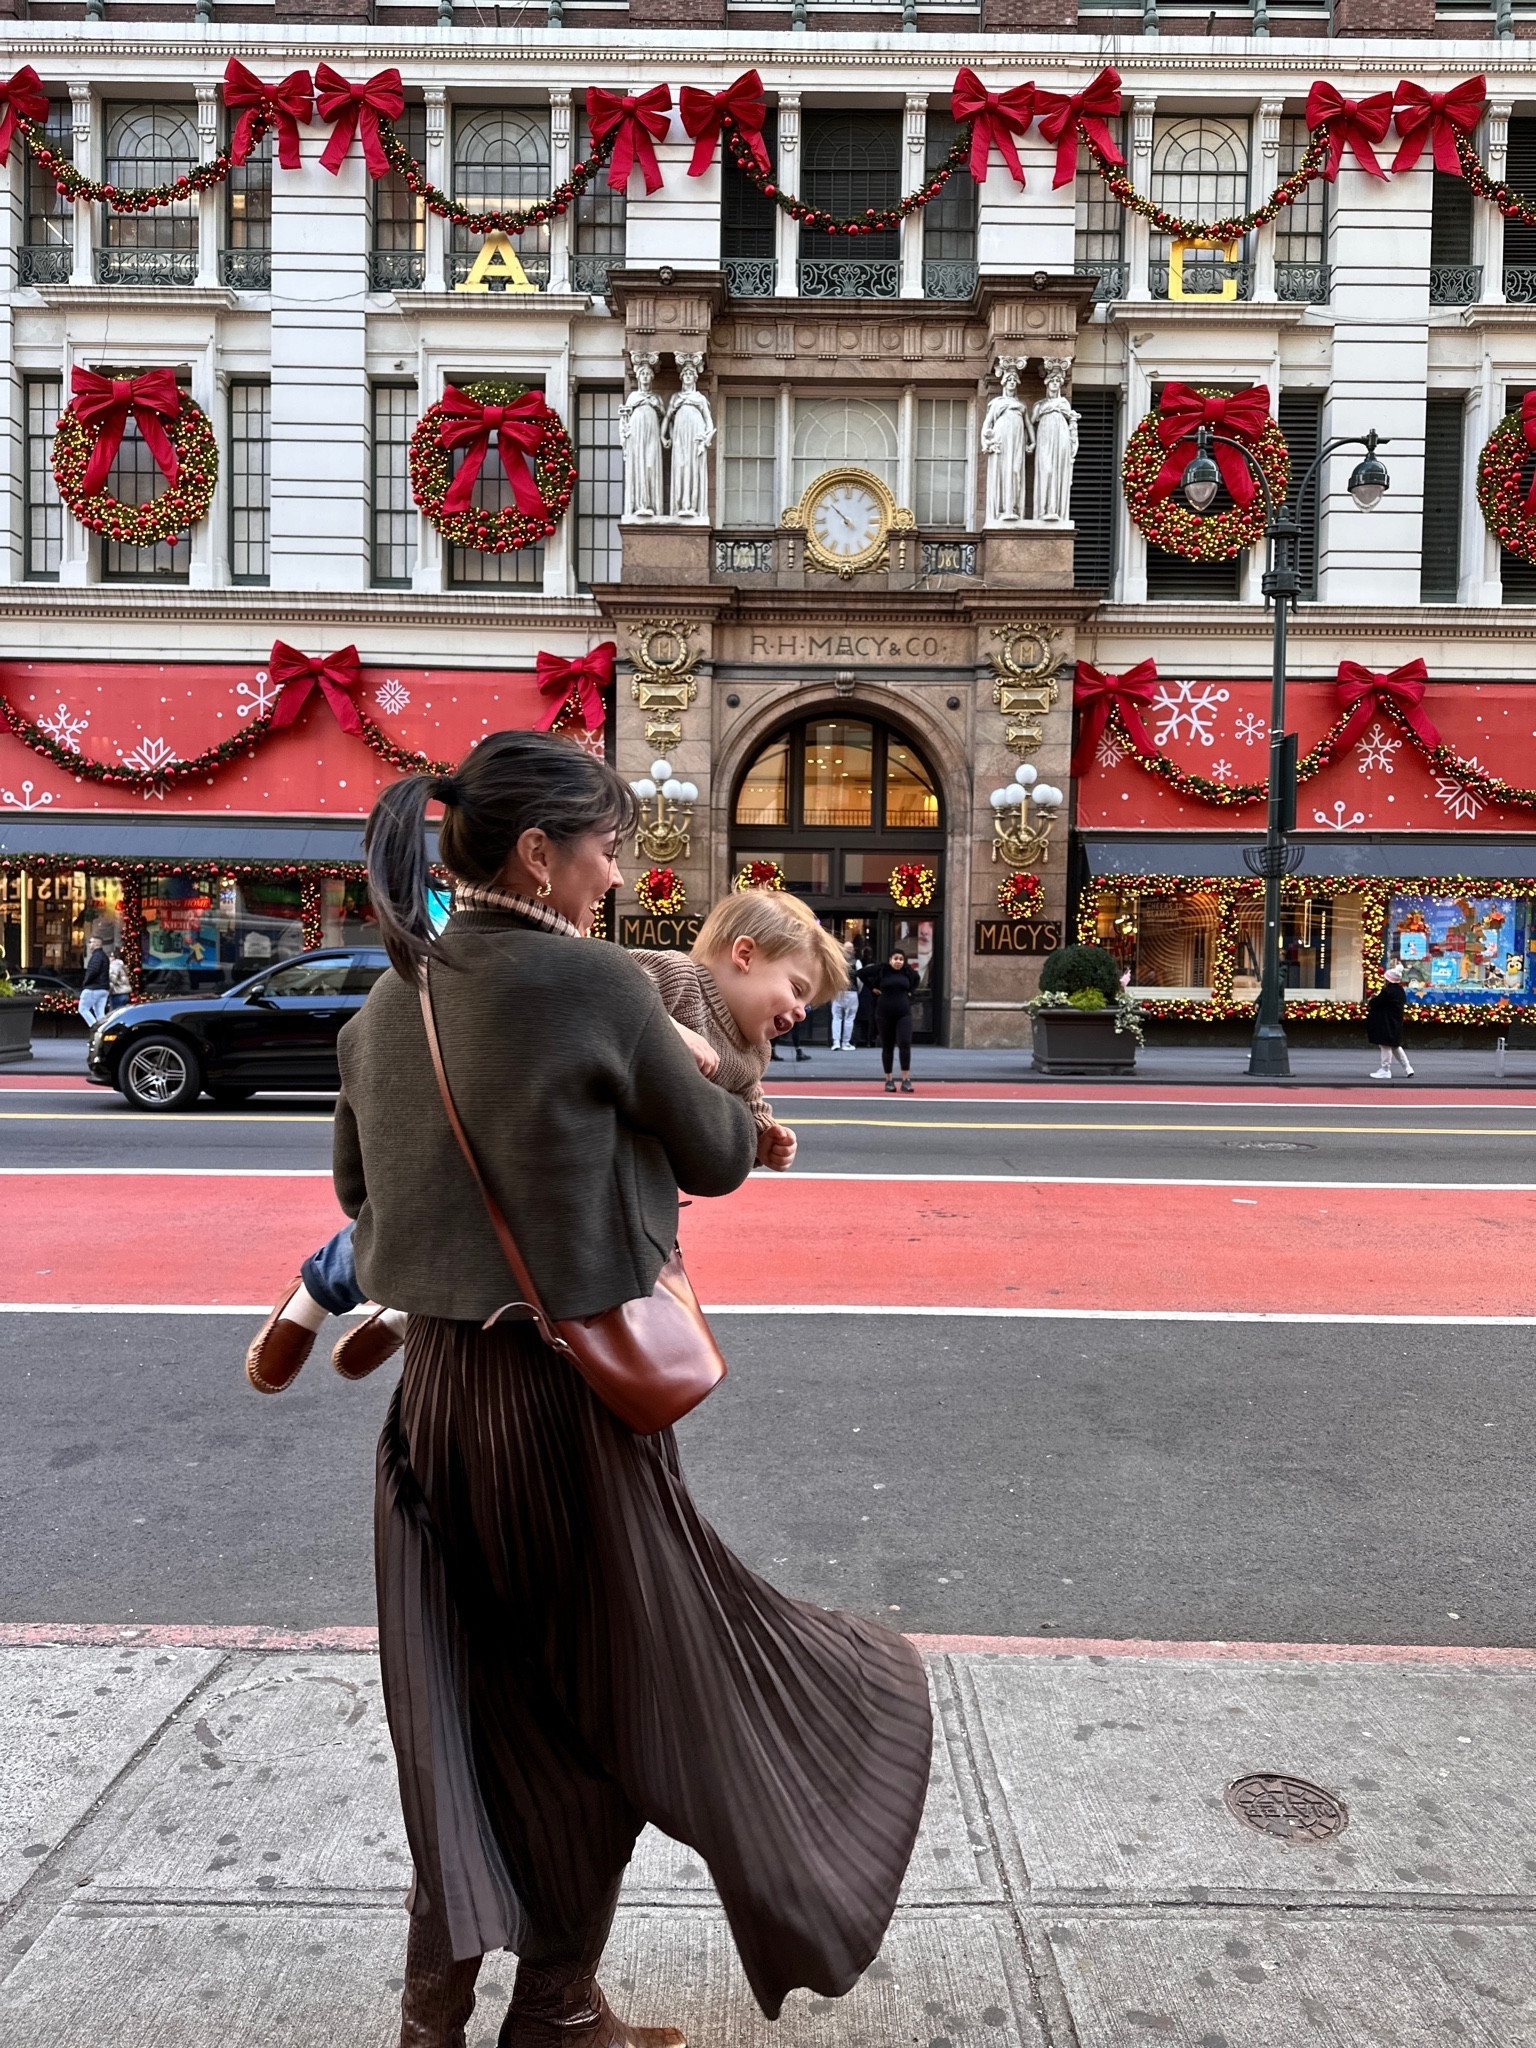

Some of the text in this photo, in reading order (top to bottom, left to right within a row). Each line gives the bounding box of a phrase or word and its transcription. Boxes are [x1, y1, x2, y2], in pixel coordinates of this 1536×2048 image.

[455, 231, 539, 292] A
[184, 899, 209, 907] HOME
[980, 924, 1058, 951] MACY'S
